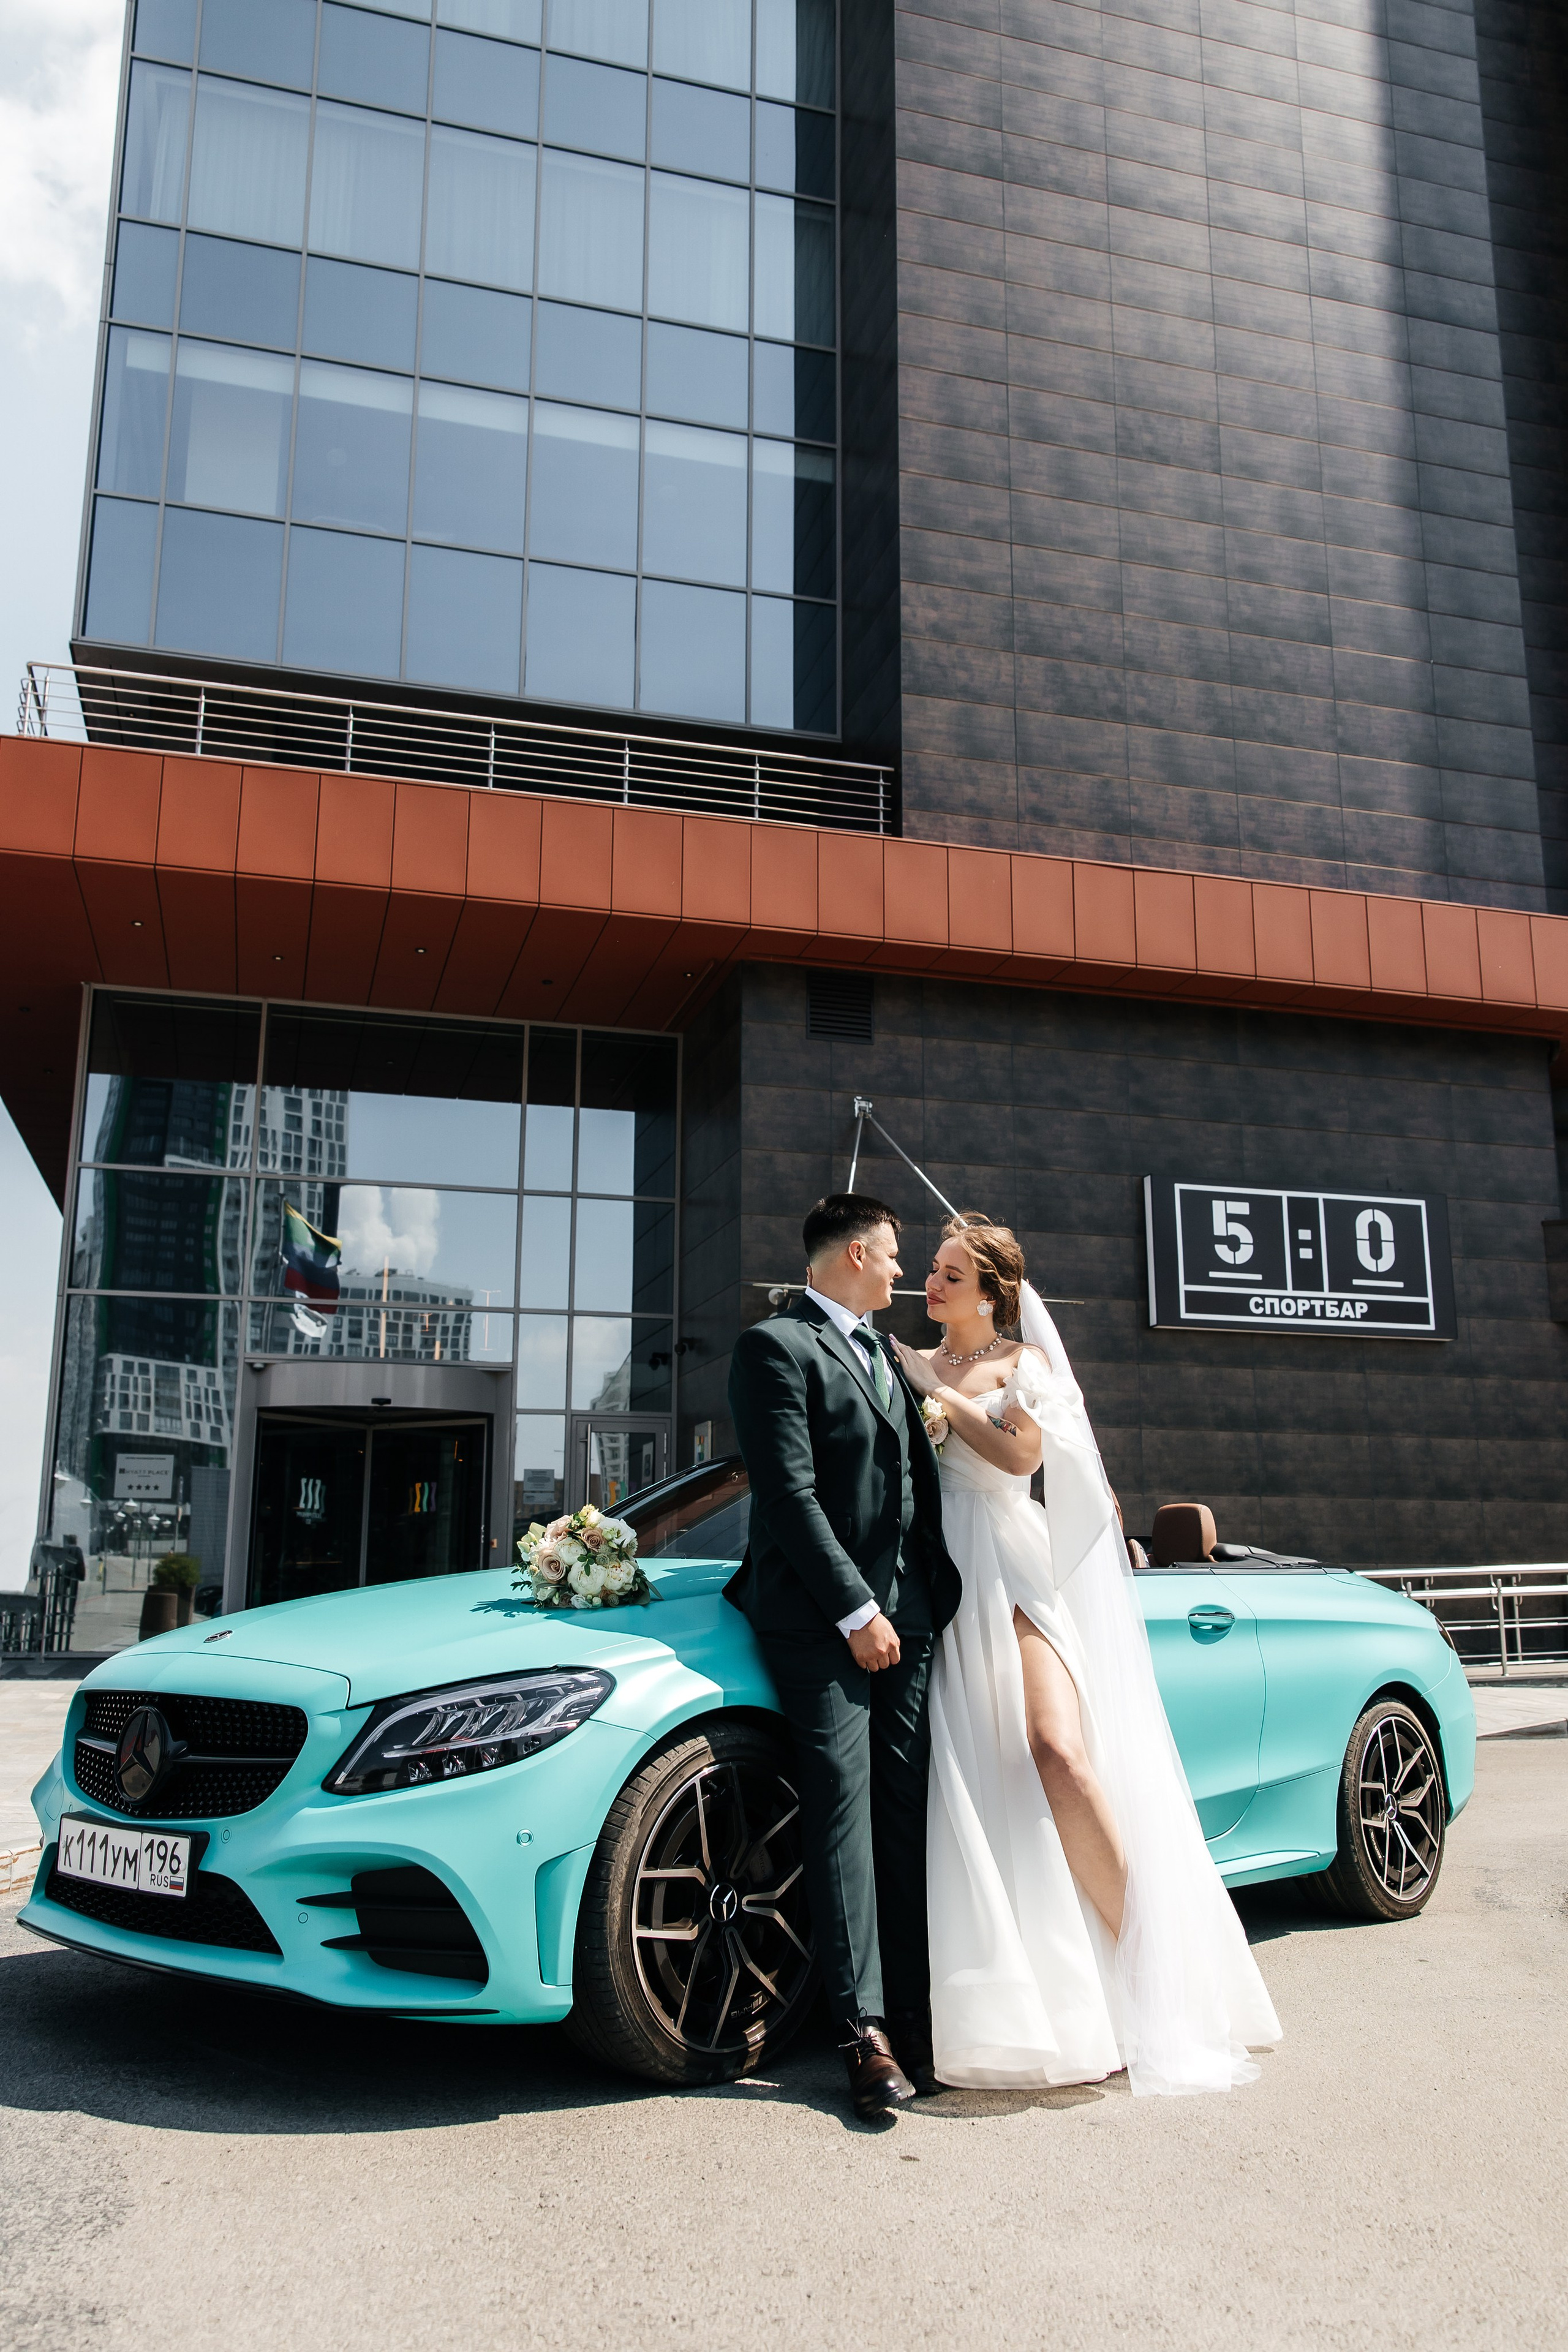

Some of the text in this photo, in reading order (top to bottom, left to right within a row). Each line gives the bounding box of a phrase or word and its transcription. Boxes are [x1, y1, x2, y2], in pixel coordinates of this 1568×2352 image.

[1212, 1200, 1254, 1265] 5
[1355, 1208, 1395, 1273] 0
[1249, 1296, 1368, 1319] СПОРТБАР
[145, 1839, 181, 1874] 196
[150, 1874, 168, 1887] RUS
[731, 2003, 753, 2019] AMG
